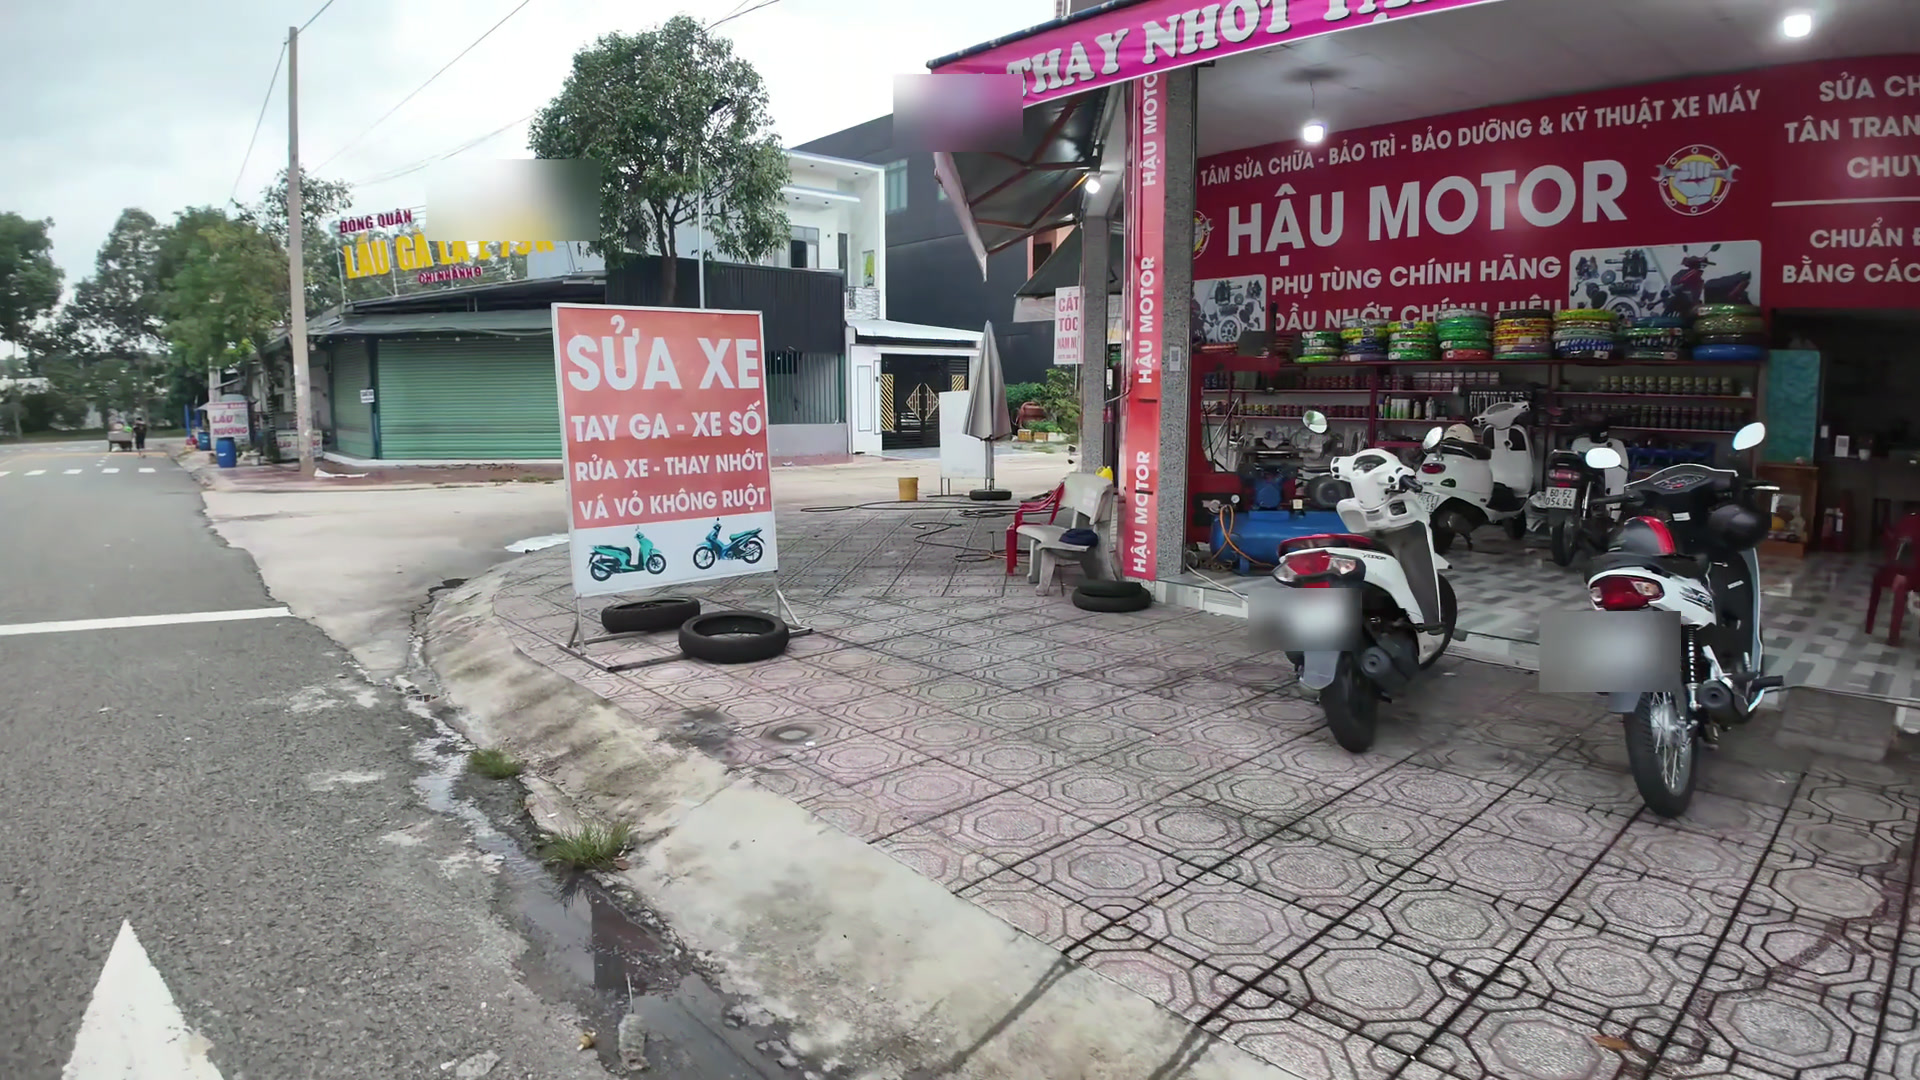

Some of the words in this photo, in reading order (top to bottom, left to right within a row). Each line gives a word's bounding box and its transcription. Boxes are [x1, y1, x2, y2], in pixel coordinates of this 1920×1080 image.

[1819, 71, 1875, 102] SỬA
[1201, 165, 1230, 186] TÂM
[1235, 157, 1263, 180] SỬA
[1268, 150, 1314, 174] CHỮA
[1329, 140, 1365, 165] BẢO
[1371, 134, 1396, 157] TRÌ
[1412, 126, 1452, 153] BẢO
[1458, 118, 1532, 147] DƯỠNG
[1538, 115, 1554, 135] &
[1561, 106, 1588, 133] KỸ
[1595, 97, 1665, 129] THUẬT
[1671, 96, 1700, 119] XE
[1708, 84, 1761, 114] MÁY
[1784, 115, 1840, 143] TÂN
[1139, 144, 1160, 186] HẬU
[1227, 182, 1345, 267] HẬU
[1368, 159, 1628, 242] MOTOR
[1809, 217, 1903, 248] CHUẨN
[1271, 274, 1313, 299] PHỤ
[1320, 266, 1382, 291] TÙNG
[1389, 257, 1471, 286] CHÍNH
[1480, 253, 1562, 282] HÃNG
[1782, 255, 1856, 283] BẰNG
[1140, 256, 1155, 333] MOTOR
[567, 314, 682, 391] SỬA
[697, 338, 760, 390] XE
[1136, 343, 1156, 384] HẬU
[571, 414, 618, 442] TAY
[629, 413, 670, 439] GA
[691, 411, 722, 437] XE
[729, 400, 762, 436] SỐ
[575, 454, 618, 481] RỬA
[624, 459, 648, 478] XE
[664, 455, 710, 475] THAY
[716, 448, 763, 472] NHỚT
[579, 493, 608, 520] VÁ
[614, 491, 643, 516] VỎ
[649, 488, 717, 514] KHÔNG
[723, 484, 766, 512] RUỘT
[1134, 451, 1151, 525] MOTOR
[1130, 530, 1150, 573] HẬU
